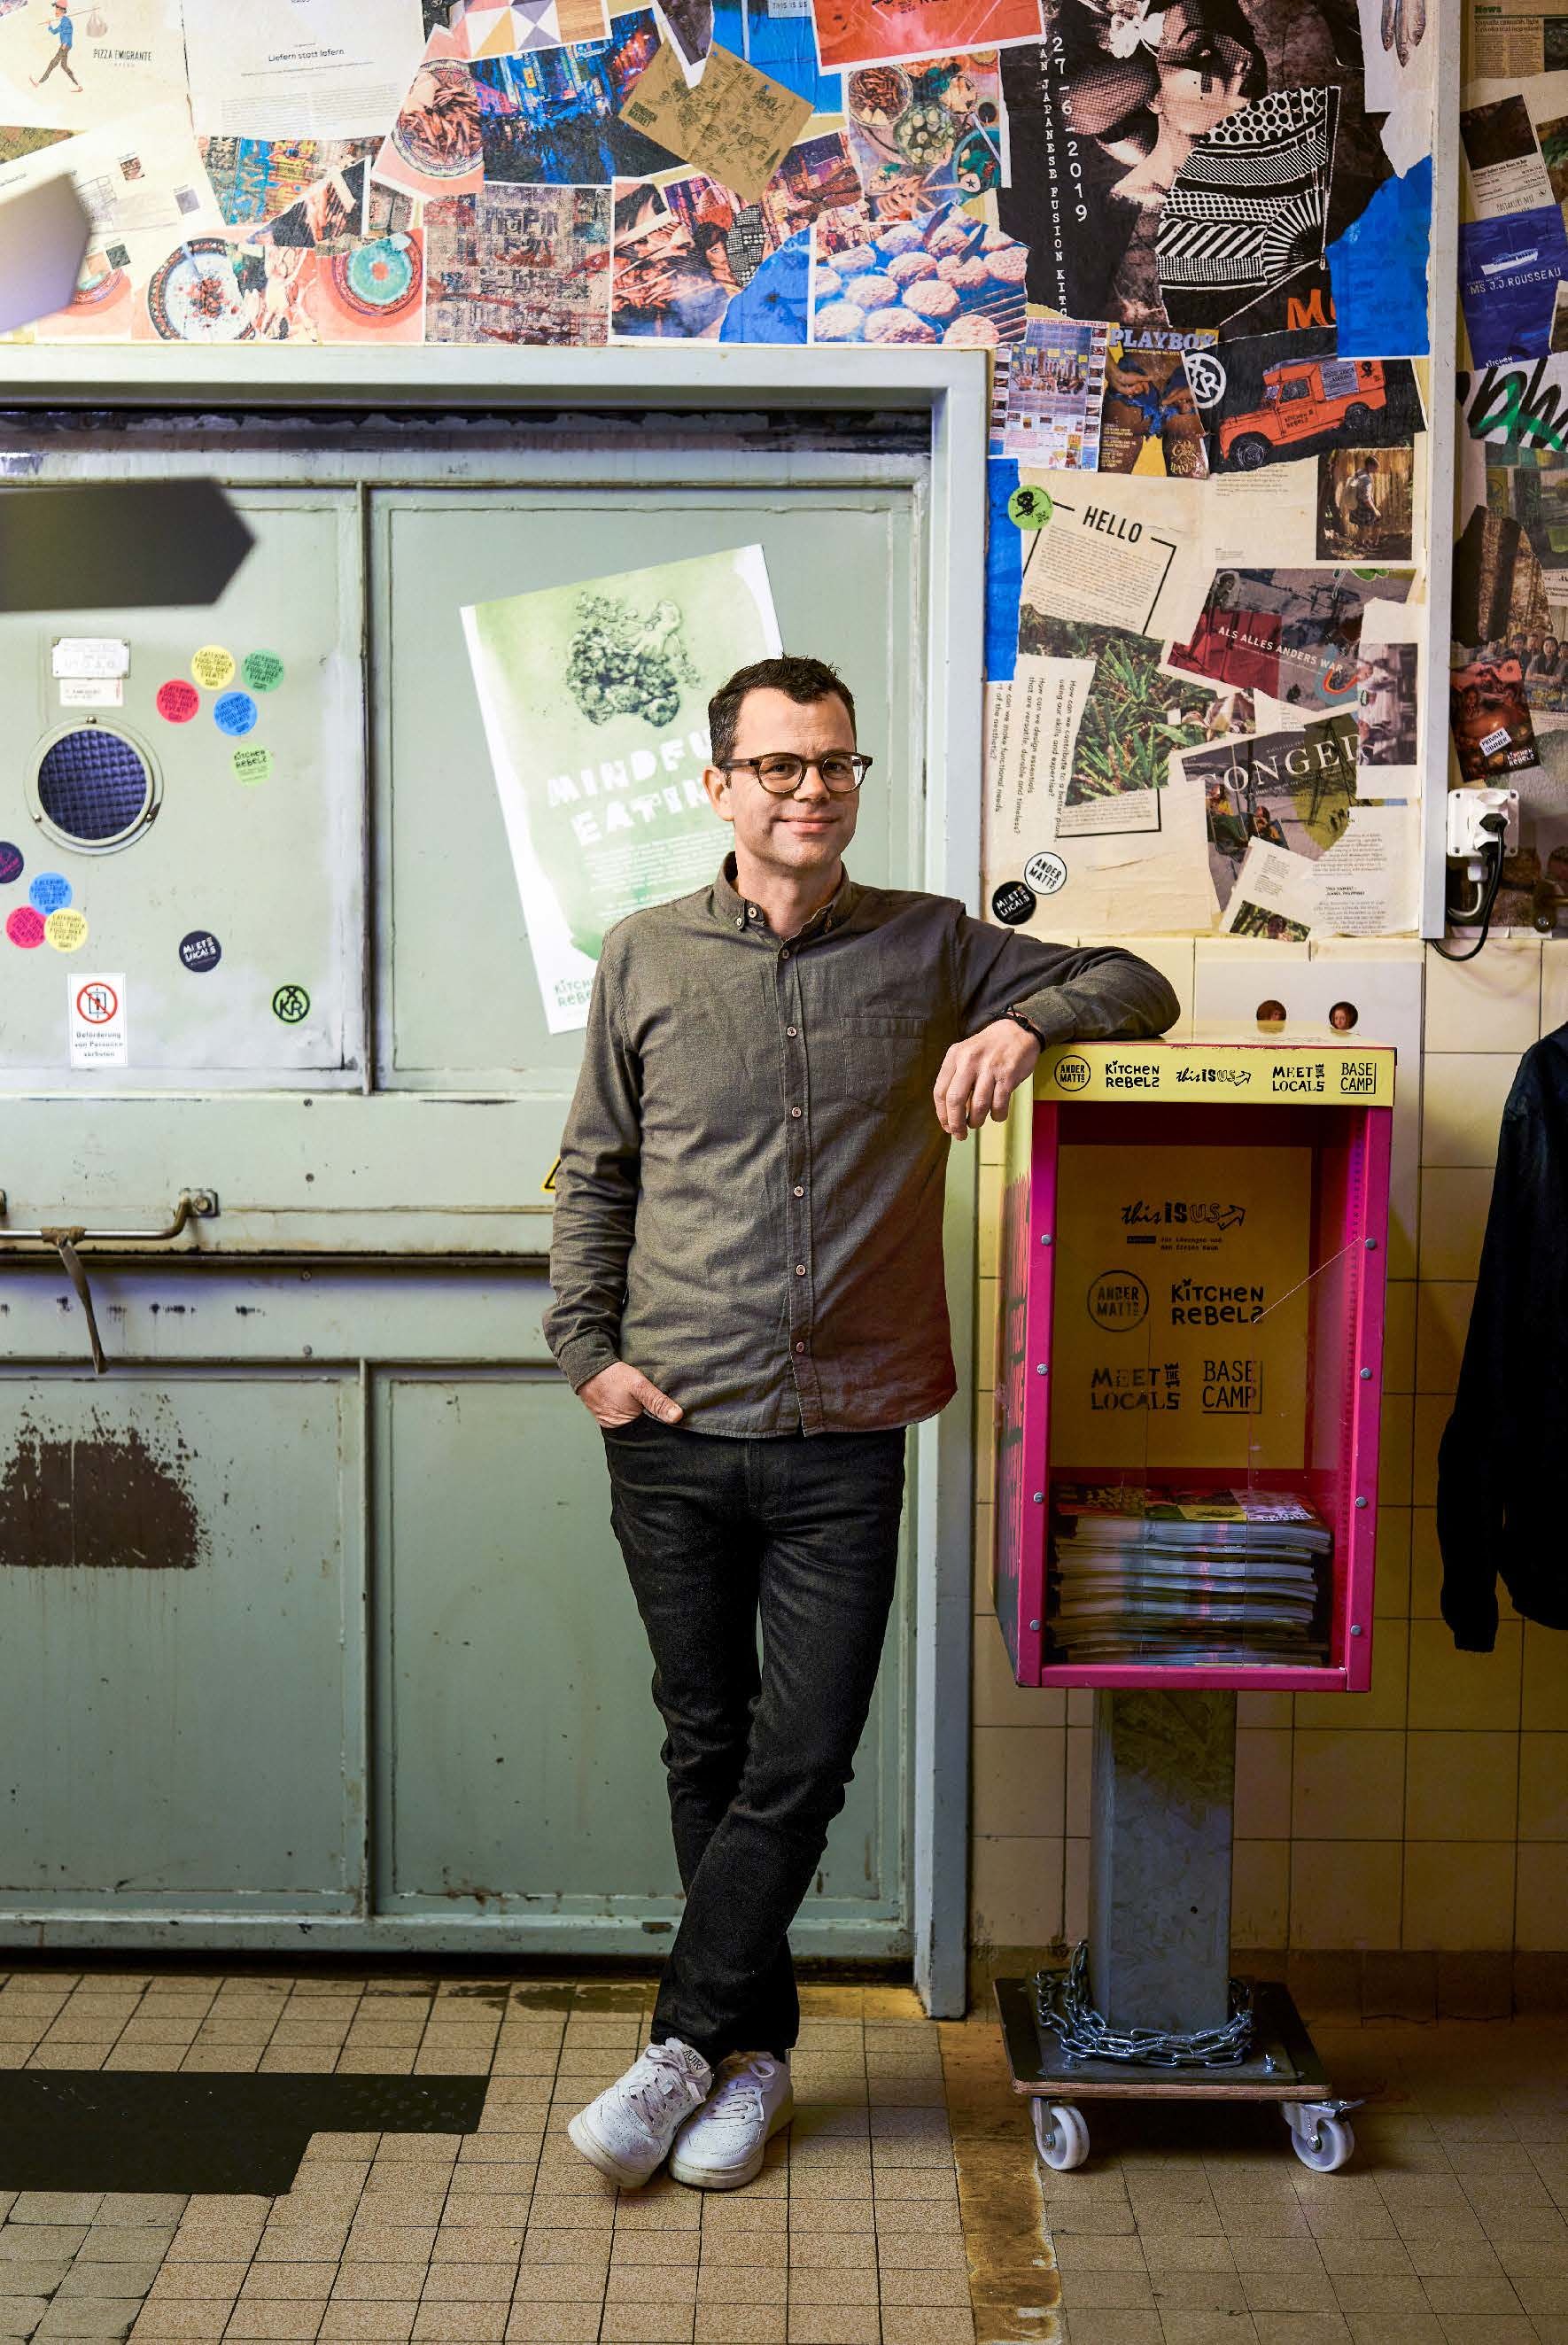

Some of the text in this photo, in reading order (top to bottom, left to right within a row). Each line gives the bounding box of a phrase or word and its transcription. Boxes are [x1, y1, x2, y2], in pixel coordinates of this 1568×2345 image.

[93, 49, 113, 59] PIZZA
[1041, 79, 1058, 179] JAPANESE
[1051, 187, 1064, 262] FUSION
[1470, 283, 1486, 295] MS
[1109, 328, 1218, 352] PLAYBOY
[1083, 505, 1143, 543] HELLO
[1218, 625, 1343, 673] ALS ALLES ANDERS WAR
[1004, 710, 1010, 721] we
[1035, 714, 1040, 725] we
[1066, 717, 1071, 727] we
[1031, 727, 1040, 751] design
[1481, 730, 1504, 747] PRIVATE
[1485, 737, 1508, 753] DINNER
[1060, 730, 1071, 769] contribute
[1018, 749, 1028, 778] durable
[1197, 734, 1360, 792] ONGE
[1056, 791, 1067, 814] better
[1035, 858, 1062, 881] ANDER
[1060, 1064, 1085, 1074] ANDER
[1272, 1066, 1314, 1078] MEET
[1341, 1063, 1373, 1075] BASE
[1272, 1080, 1325, 1092] LOCALS
[1340, 1077, 1373, 1091] CAMP
[1098, 1286, 1139, 1301] ANDER
[1091, 1367, 1160, 1388] MEET
[1203, 1361, 1257, 1382] BASE
[1091, 1392, 1181, 1410] LOCALS
[1202, 1386, 1257, 1408] CAMP
